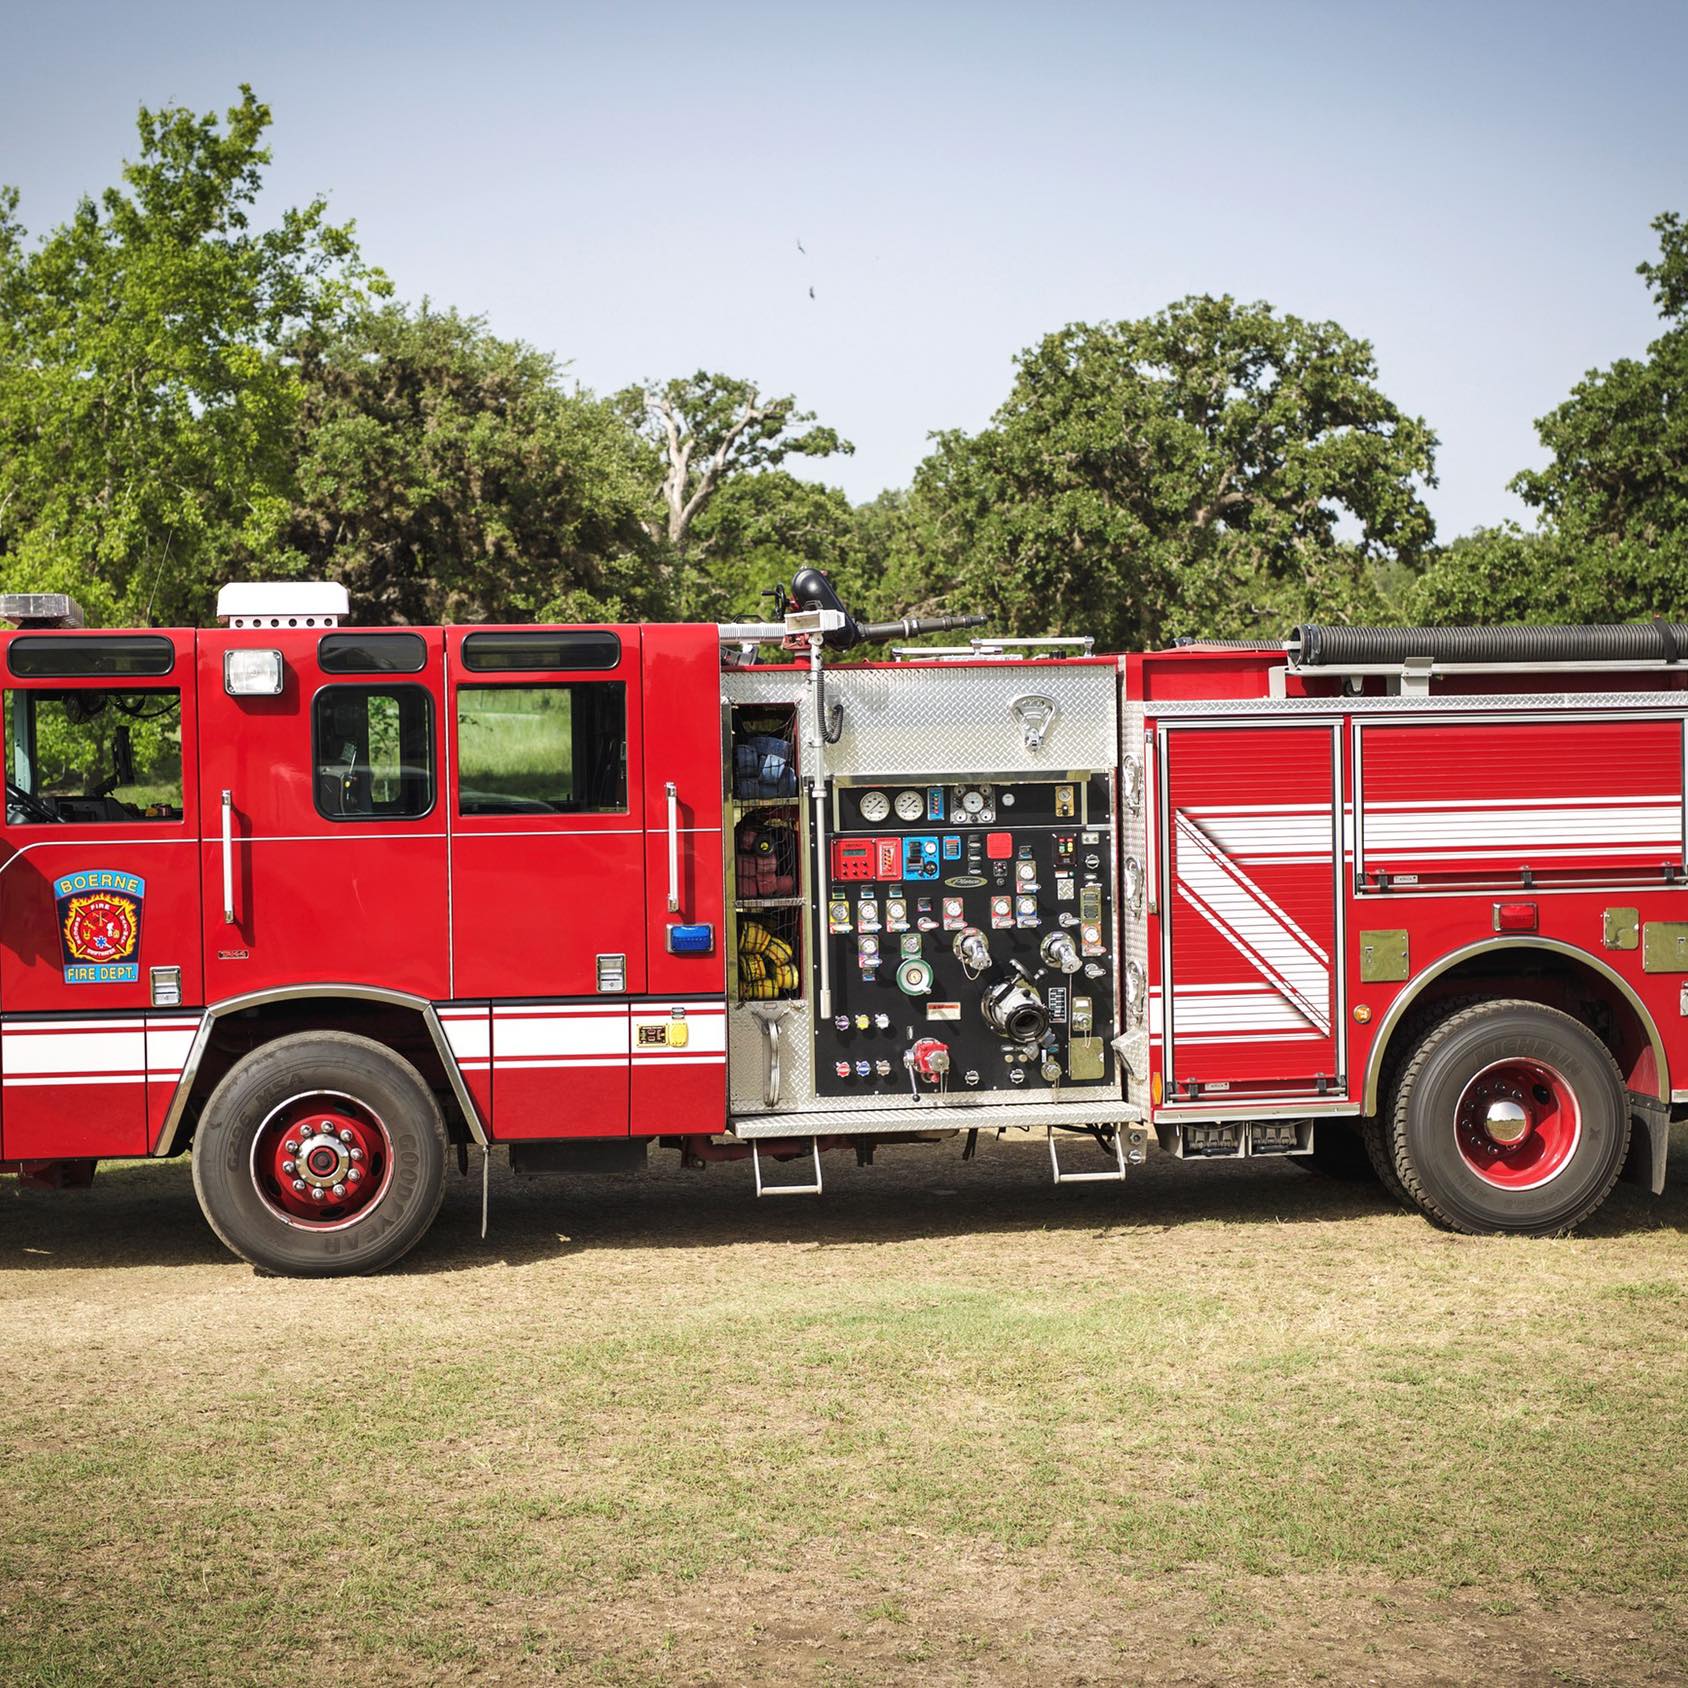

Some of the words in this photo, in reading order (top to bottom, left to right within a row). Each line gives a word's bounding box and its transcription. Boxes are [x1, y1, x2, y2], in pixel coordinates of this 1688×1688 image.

[60, 874, 139, 893] BOERNE
[67, 967, 96, 981] FIRE
[100, 966, 136, 980] DEPT.
[1473, 1038, 1583, 1073] MICHELIN
[324, 1134, 419, 1254] GOODYEAR
